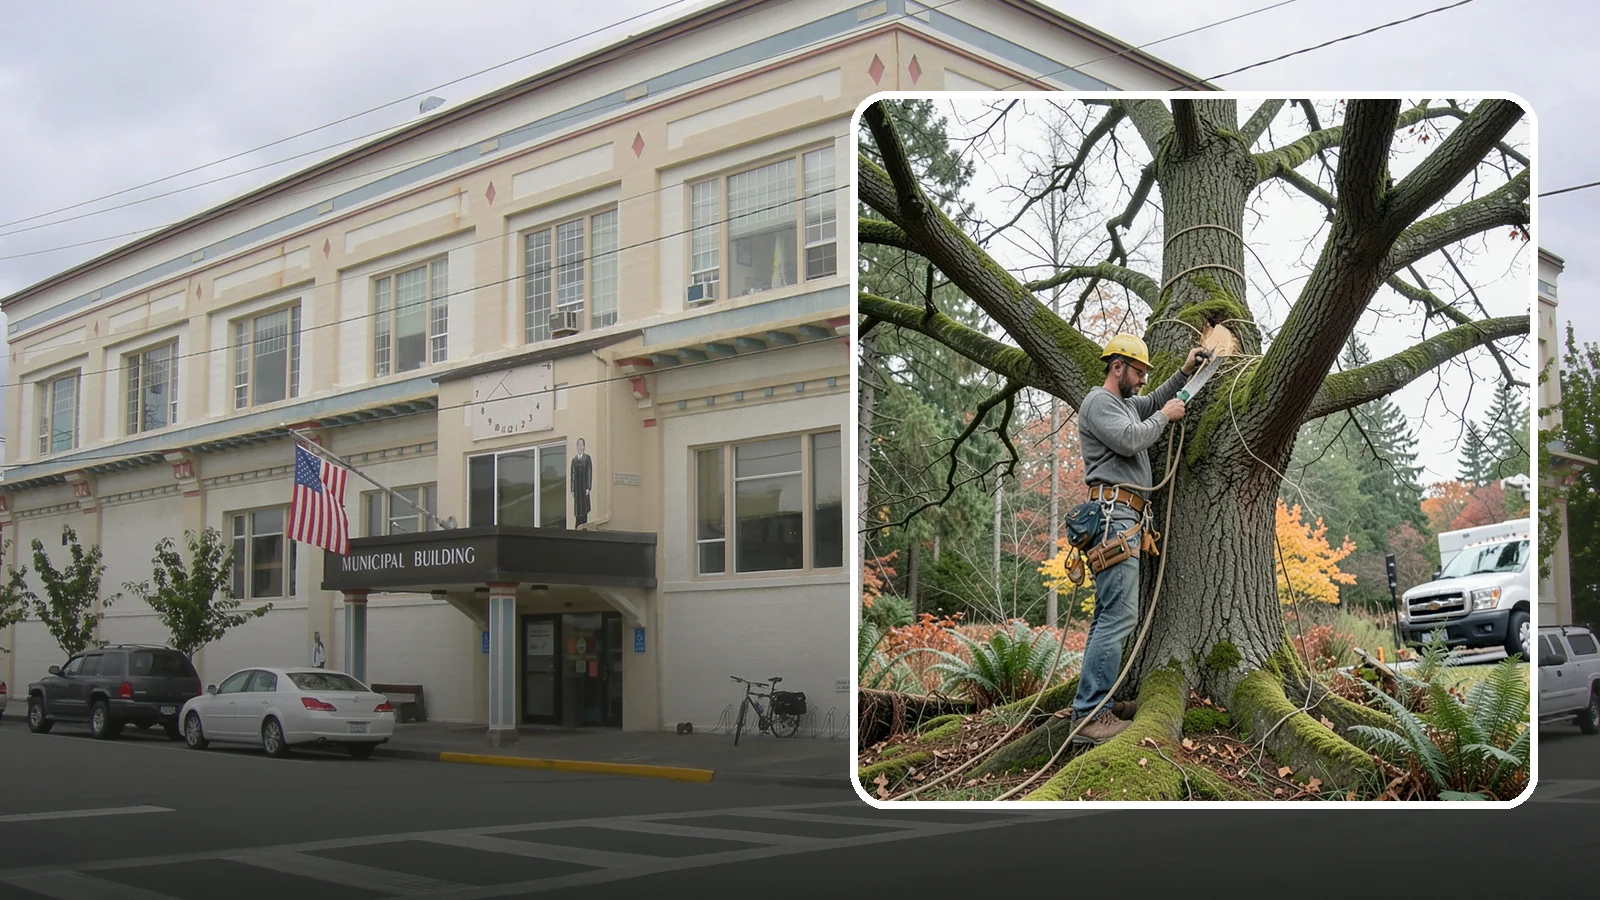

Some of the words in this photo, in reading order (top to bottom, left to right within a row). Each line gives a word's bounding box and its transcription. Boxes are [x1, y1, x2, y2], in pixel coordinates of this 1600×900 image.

[488, 418, 492, 426] 9
[529, 414, 532, 422] 3
[495, 424, 500, 432] 10
[342, 553, 405, 572] MUNICIPAL
[414, 546, 475, 567] BUILDING
